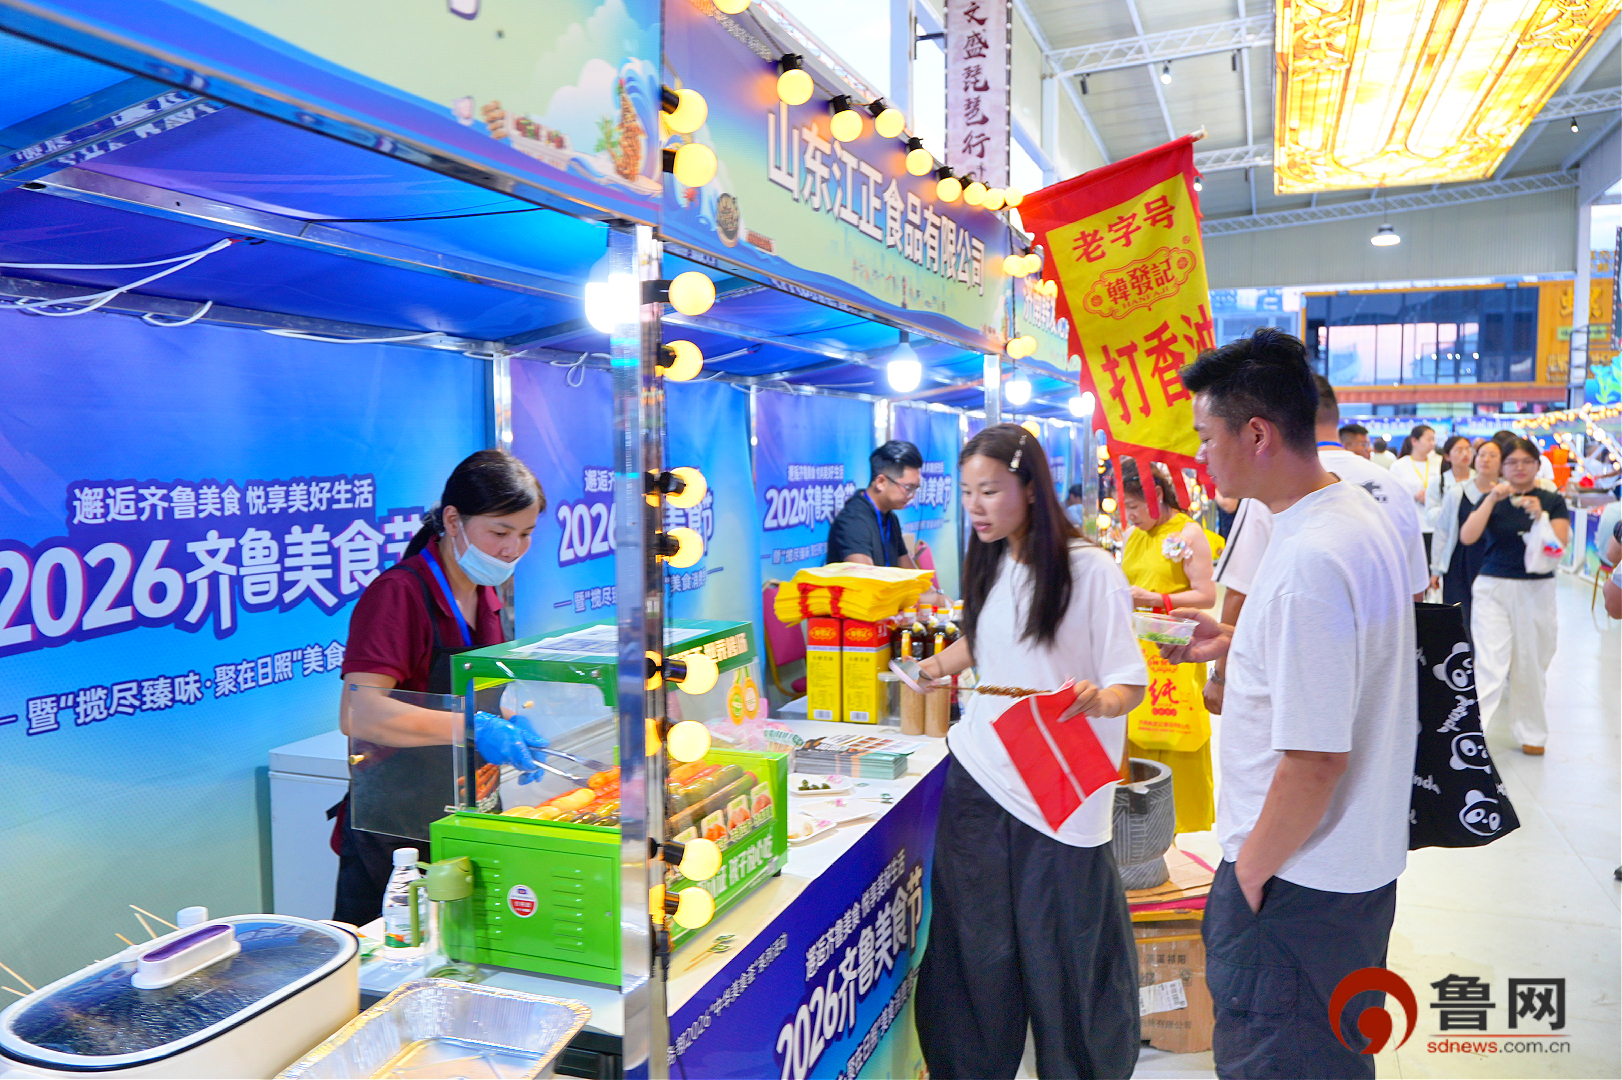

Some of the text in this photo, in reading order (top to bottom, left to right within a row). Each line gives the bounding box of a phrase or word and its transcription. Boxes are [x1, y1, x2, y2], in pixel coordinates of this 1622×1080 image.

[767, 100, 985, 297] 山东江正食品有限公司
[1072, 194, 1176, 263] 老字号
[1106, 258, 1175, 305] 韓發記
[1122, 286, 1170, 309] HANFAJI
[73, 479, 374, 525] 邂逅齐鲁美食 悦享美好生活
[776, 865, 923, 1080] 2026齐鲁美食节
